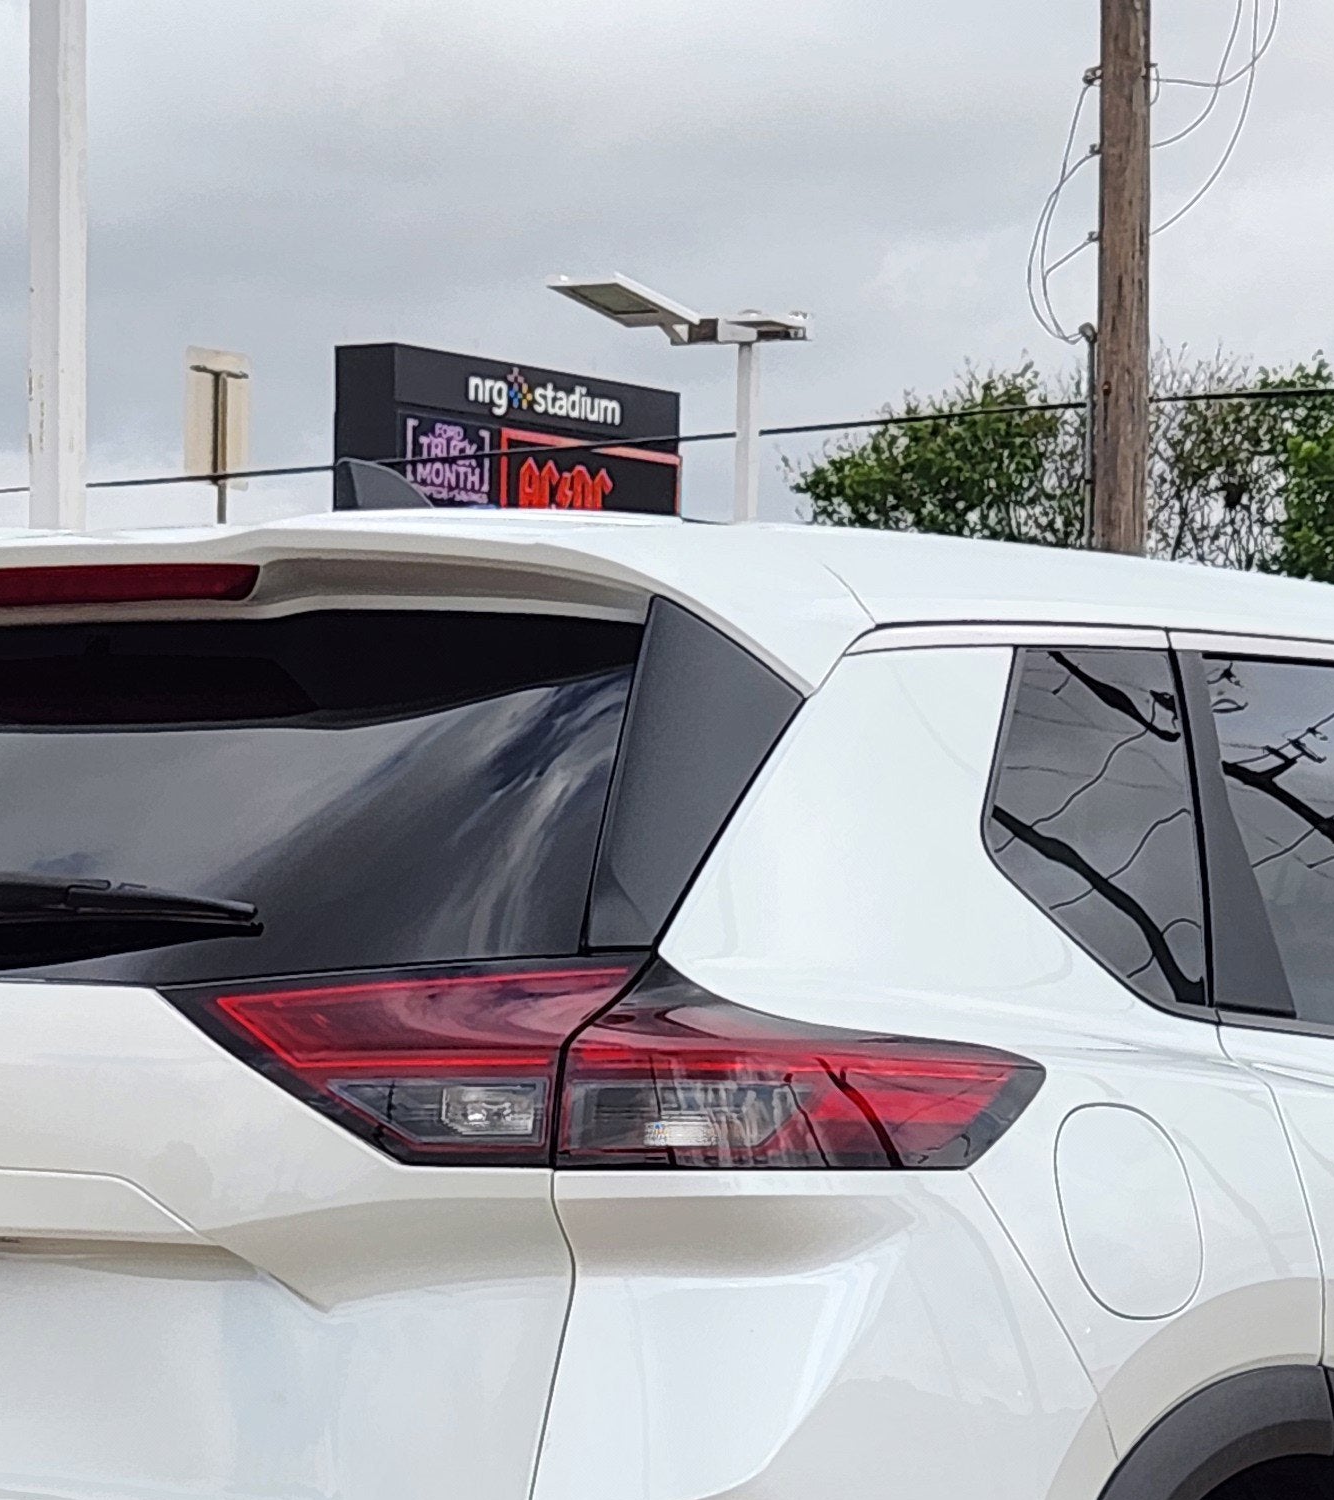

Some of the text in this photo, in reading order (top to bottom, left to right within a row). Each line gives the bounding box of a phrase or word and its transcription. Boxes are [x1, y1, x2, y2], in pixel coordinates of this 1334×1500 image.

[468, 376, 622, 426] nrg stadium
[416, 461, 481, 491] MONTH
